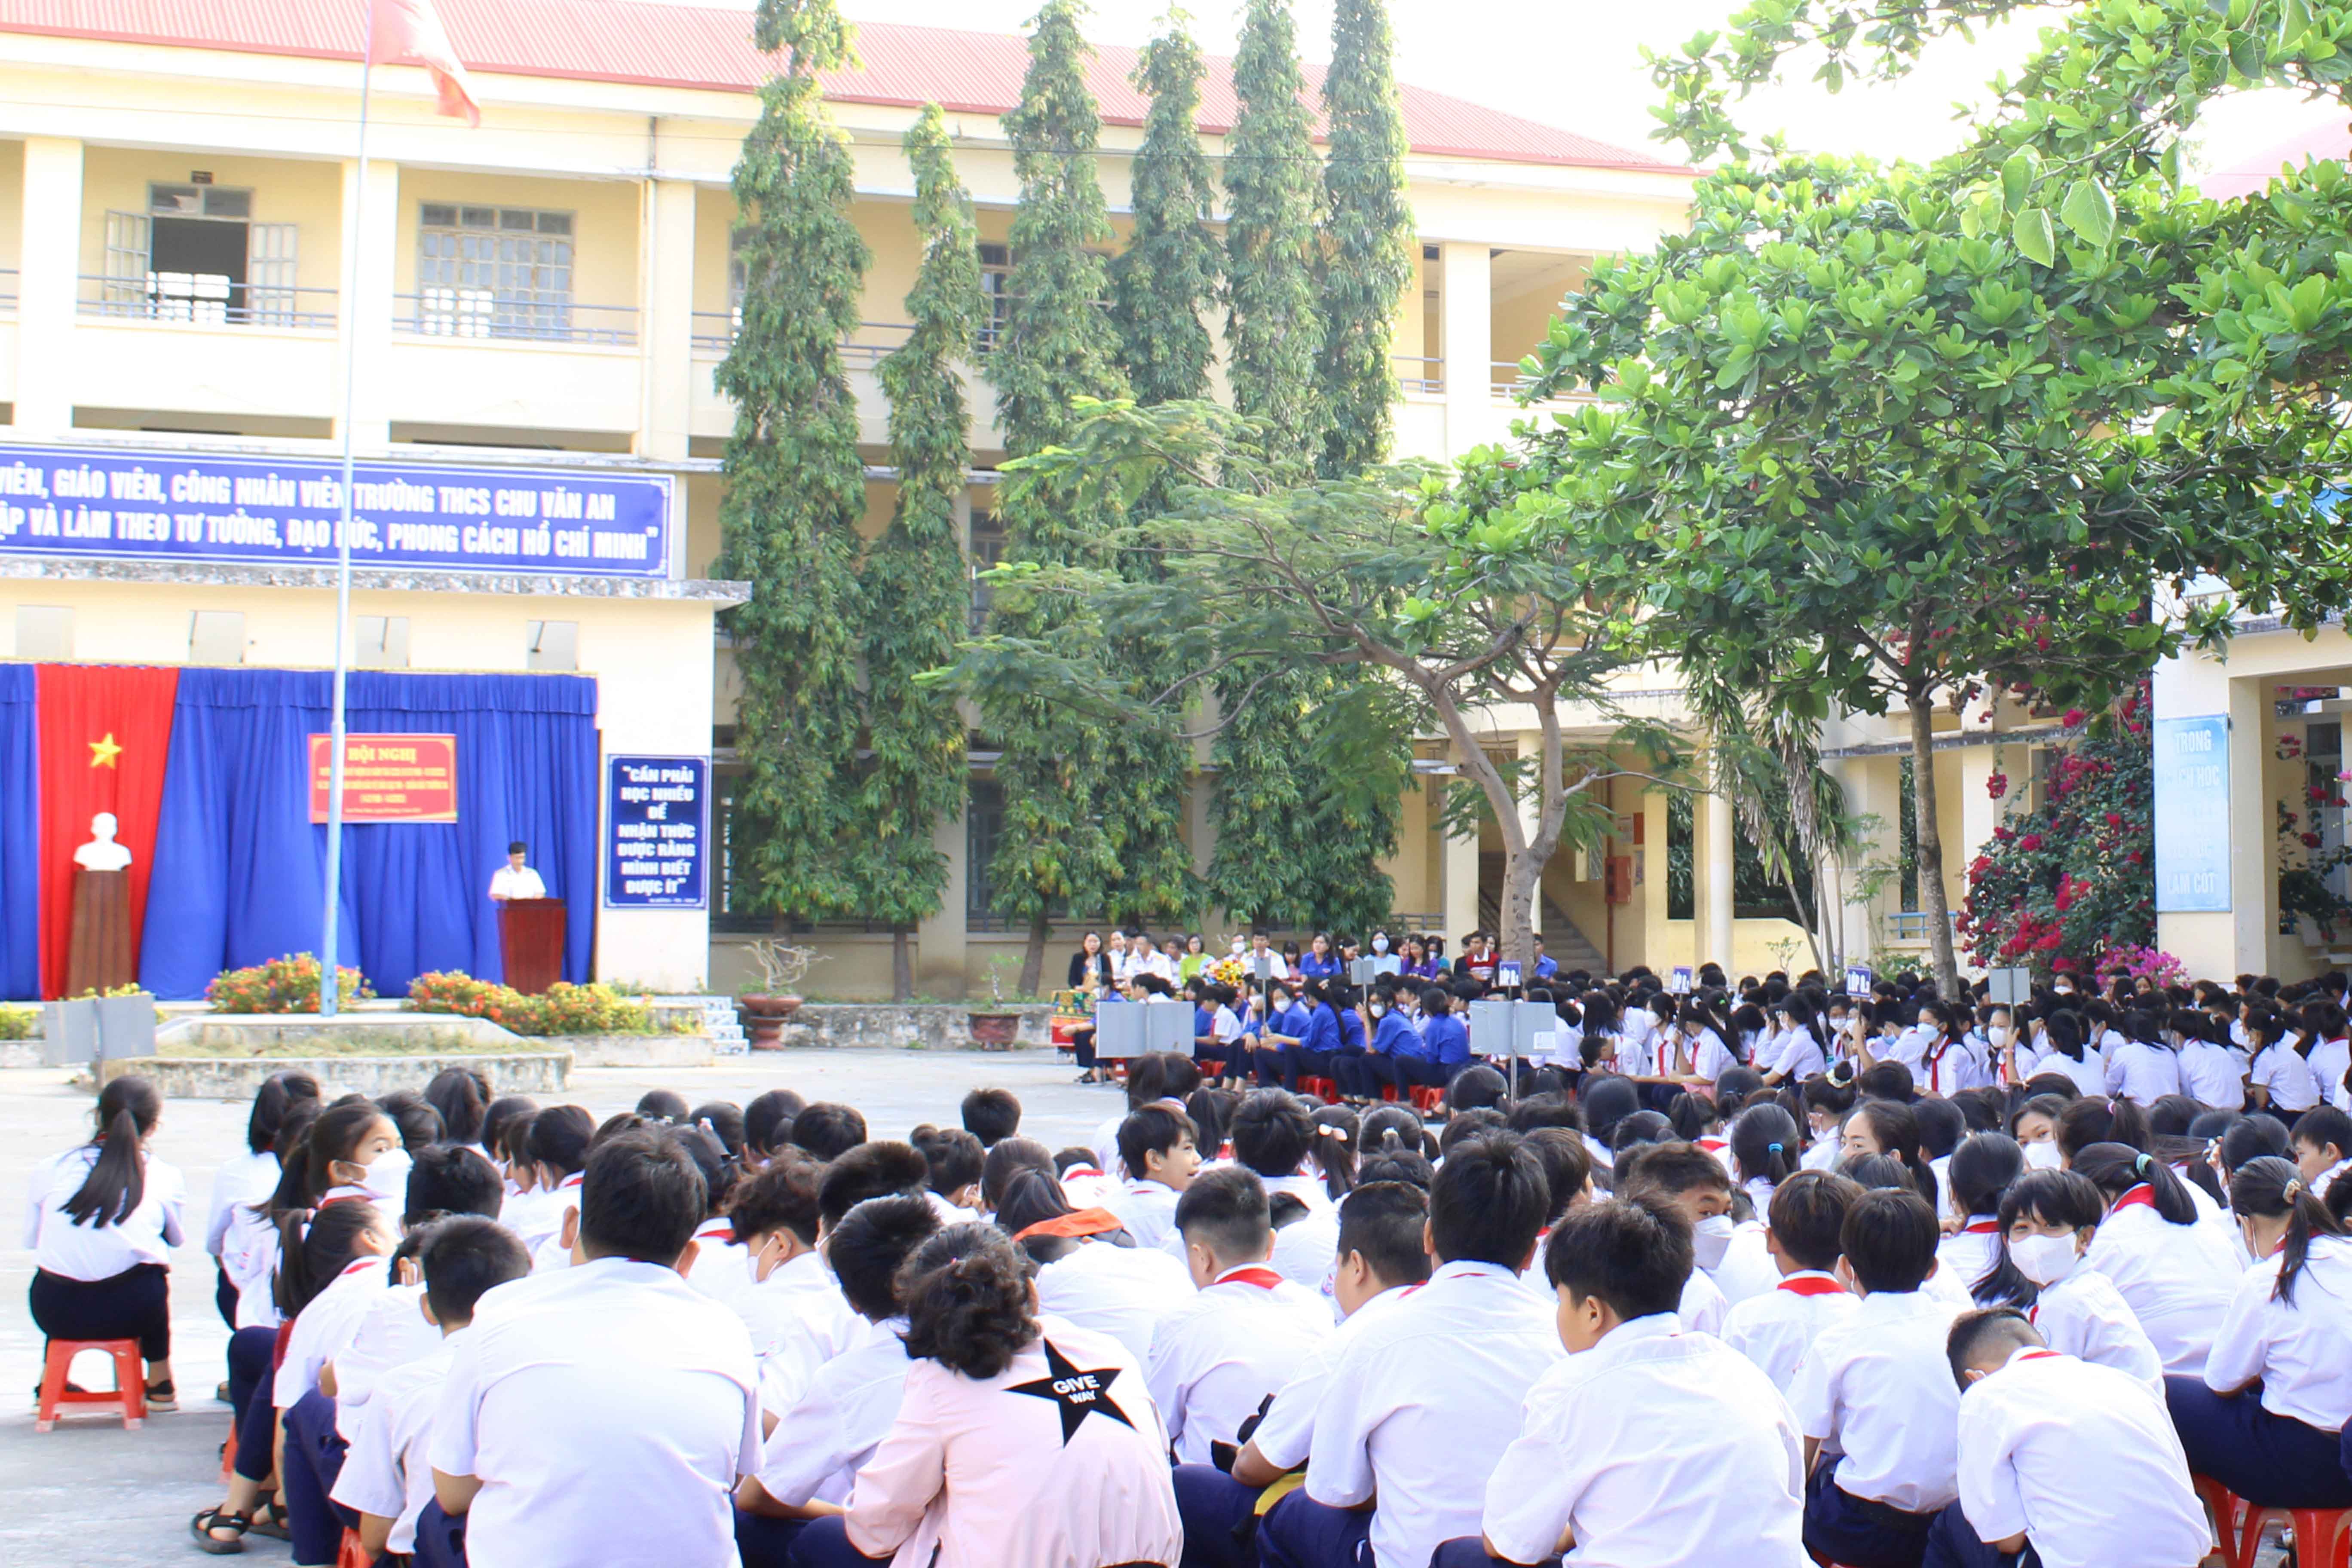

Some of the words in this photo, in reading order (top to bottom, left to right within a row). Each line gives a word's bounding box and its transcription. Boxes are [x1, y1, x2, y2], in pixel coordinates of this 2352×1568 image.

[53, 464, 107, 499] GIÁO
[110, 466, 167, 504] VIÊN,
[171, 469, 232, 504] CÔNG
[235, 473, 297, 507] NHÂN
[352, 477, 435, 512] TRƯỜNG
[438, 487, 491, 515] THCS
[496, 489, 537, 518] CHU
[541, 486, 582, 519] VĂN
[585, 493, 616, 521] AN
[29, 502, 59, 537] VÀ
[63, 504, 112, 539] LÀM
[115, 511, 171, 542] THEO
[174, 512, 205, 542] TƯ
[206, 507, 283, 549] TƯỞNG,
[286, 518, 331, 553] ĐẠO
[388, 523, 459, 553] PHONG
[462, 521, 518, 555] CÁCH
[521, 520, 551, 556] HỒ
[554, 525, 590, 557] CHÍ
[2174, 729, 2211, 753] TRONG
[347, 744, 375, 764] HỘI
[378, 747, 417, 764] NGHỊ
[661, 766, 694, 783] PHẢI
[621, 787, 649, 803] HỌC
[618, 822, 658, 840] NHẬN
[659, 822, 696, 838] THỨC
[617, 842, 655, 859] ĐƯỢC
[621, 860, 659, 875] MÌNH
[661, 858, 692, 875] BIẾT
[625, 879, 663, 897] ĐƯỢC
[1053, 1375, 1100, 1394] GIVE
[1068, 1390, 1096, 1404] WAY
